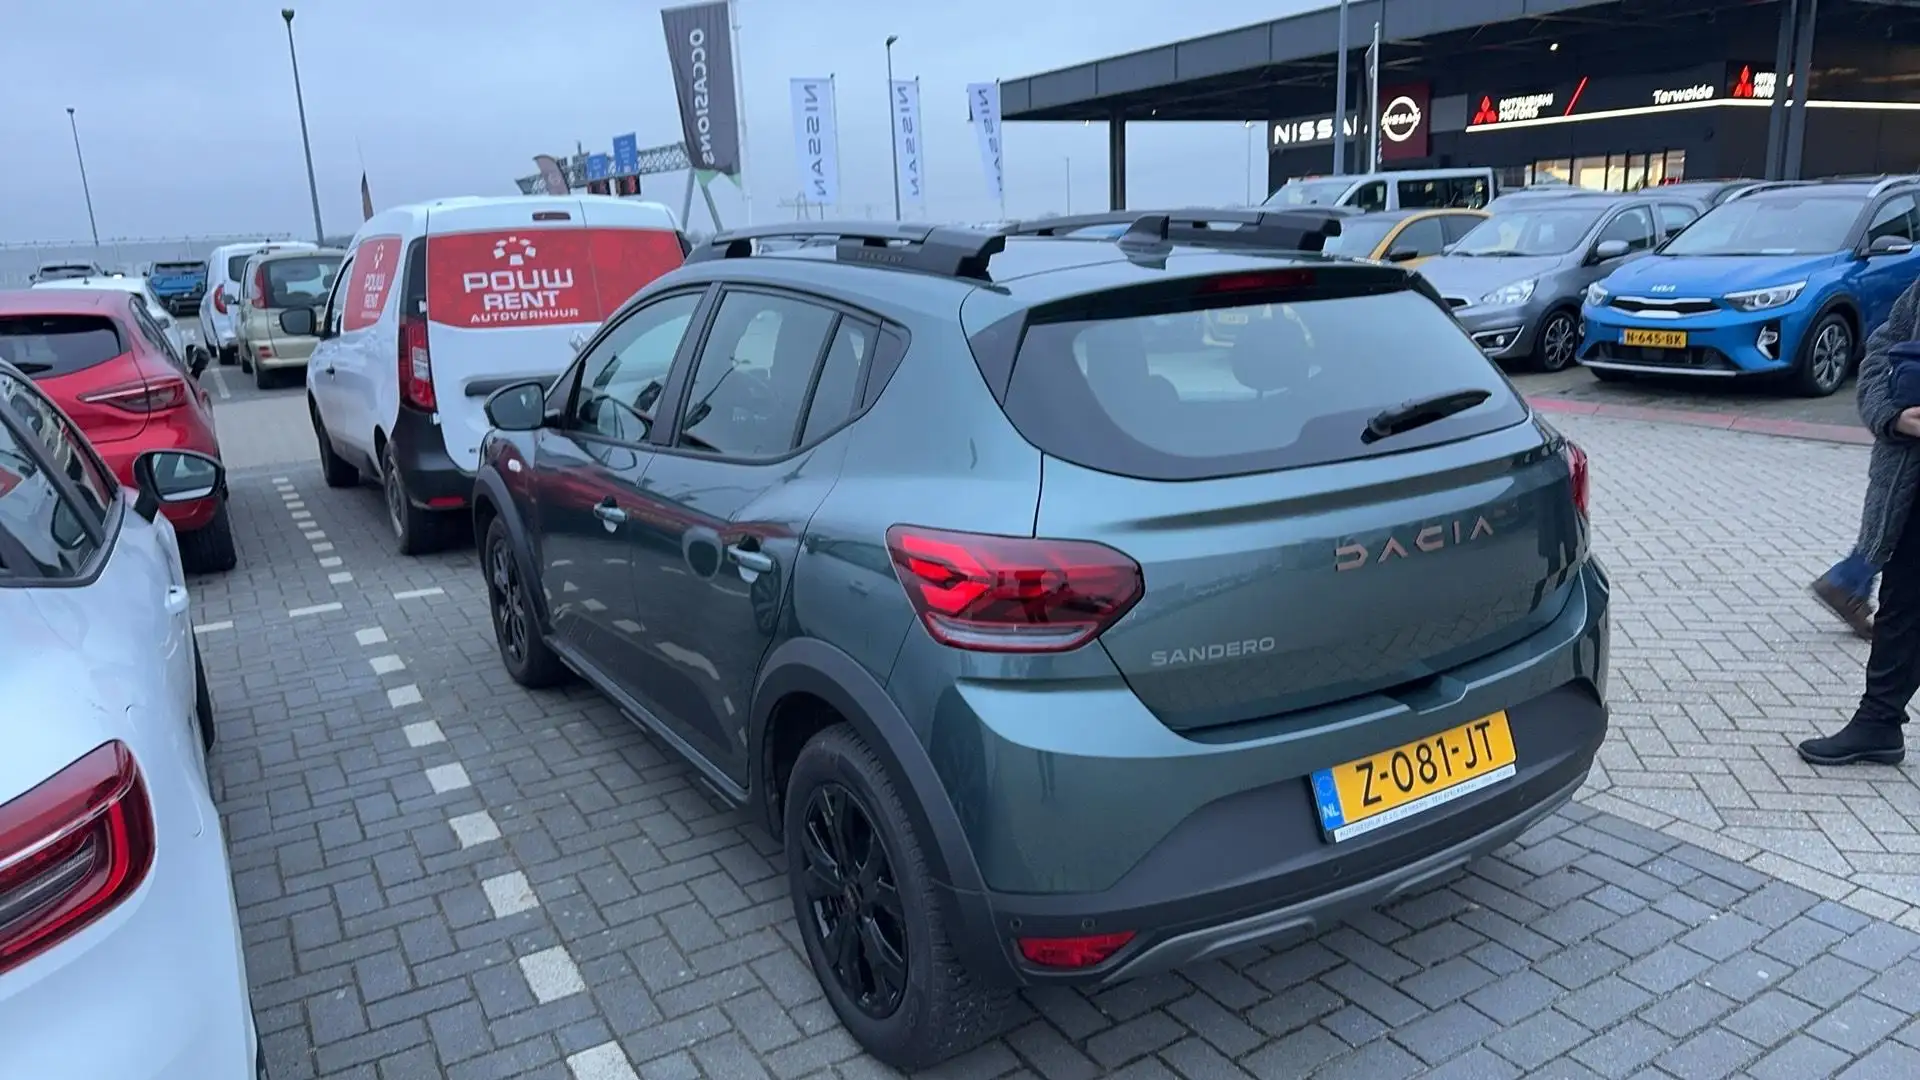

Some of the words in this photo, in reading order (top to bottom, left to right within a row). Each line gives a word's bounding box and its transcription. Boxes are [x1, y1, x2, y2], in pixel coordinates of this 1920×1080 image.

[463, 268, 573, 293] POUW
[484, 290, 560, 311] RENT
[471, 308, 579, 323] AUTOVERHUUR
[1335, 515, 1494, 571] DACIA
[1151, 636, 1276, 666] SANDERO
[1356, 720, 1492, 807] Z-081-JT
[1323, 804, 1340, 818] NL
